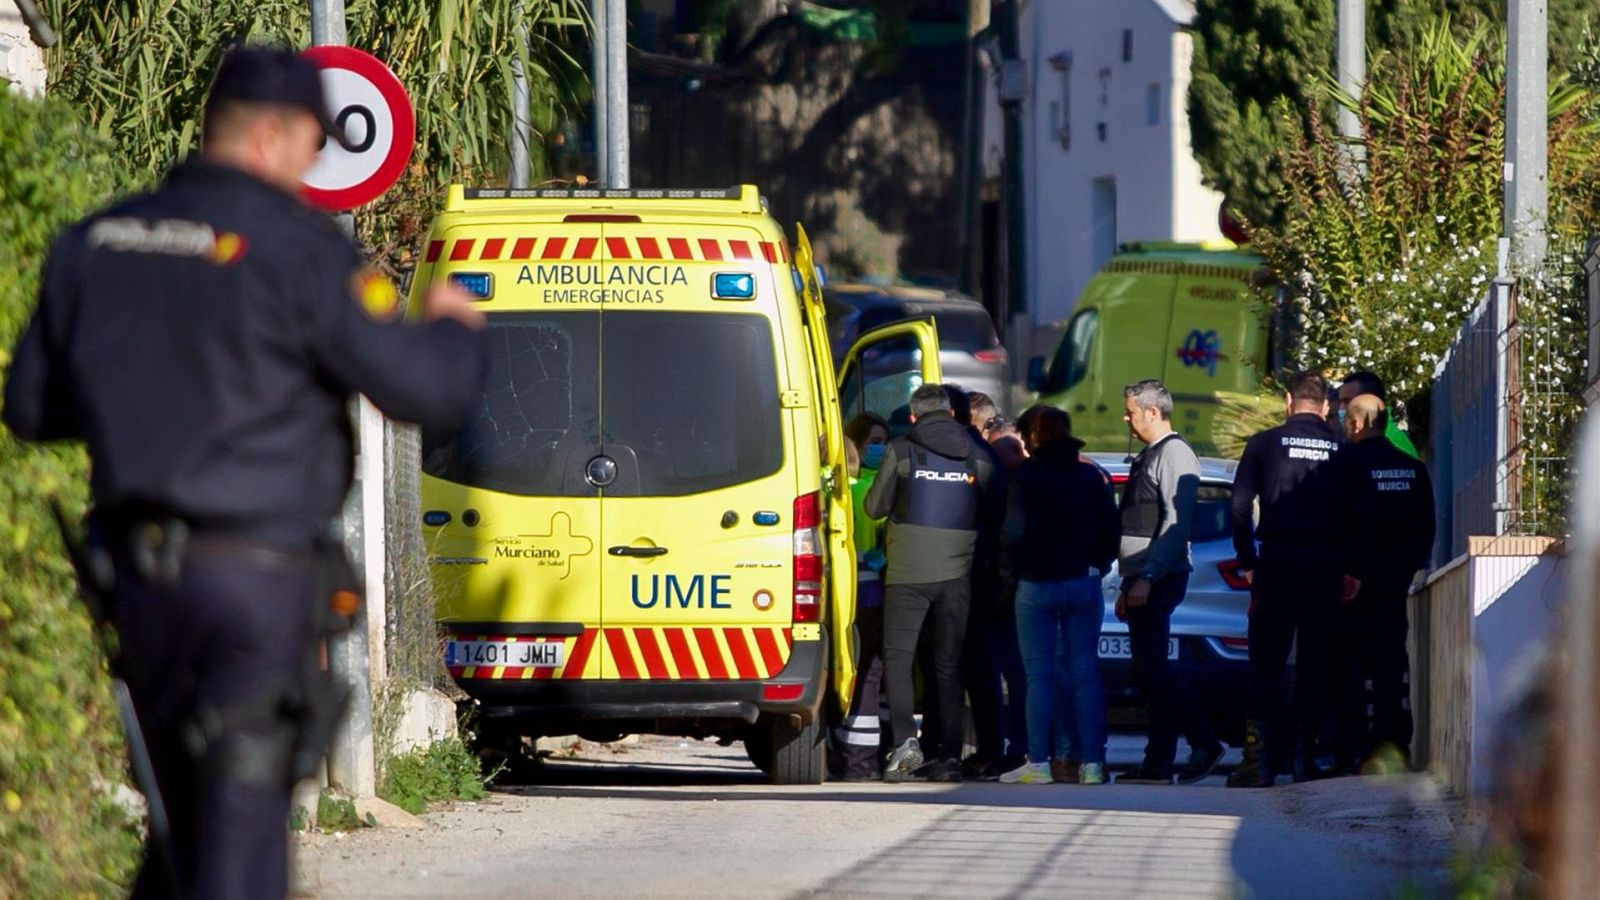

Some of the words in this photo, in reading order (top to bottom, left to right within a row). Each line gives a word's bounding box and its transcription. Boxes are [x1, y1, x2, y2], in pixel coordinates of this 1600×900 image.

[335, 104, 377, 153] 0
[516, 265, 688, 286] AMBULANCIA
[543, 289, 664, 304] EMERGENCIAS
[1281, 437, 1338, 451] BOMBEROS
[1289, 447, 1330, 461] MURCIA
[915, 470, 969, 482] POLICIA
[1377, 481, 1410, 491] MURCIA
[494, 545, 560, 559] Murciano
[630, 574, 732, 609] UME
[1099, 637, 1131, 655] 033
[463, 644, 508, 663] 1401
[520, 645, 557, 664] JMH
